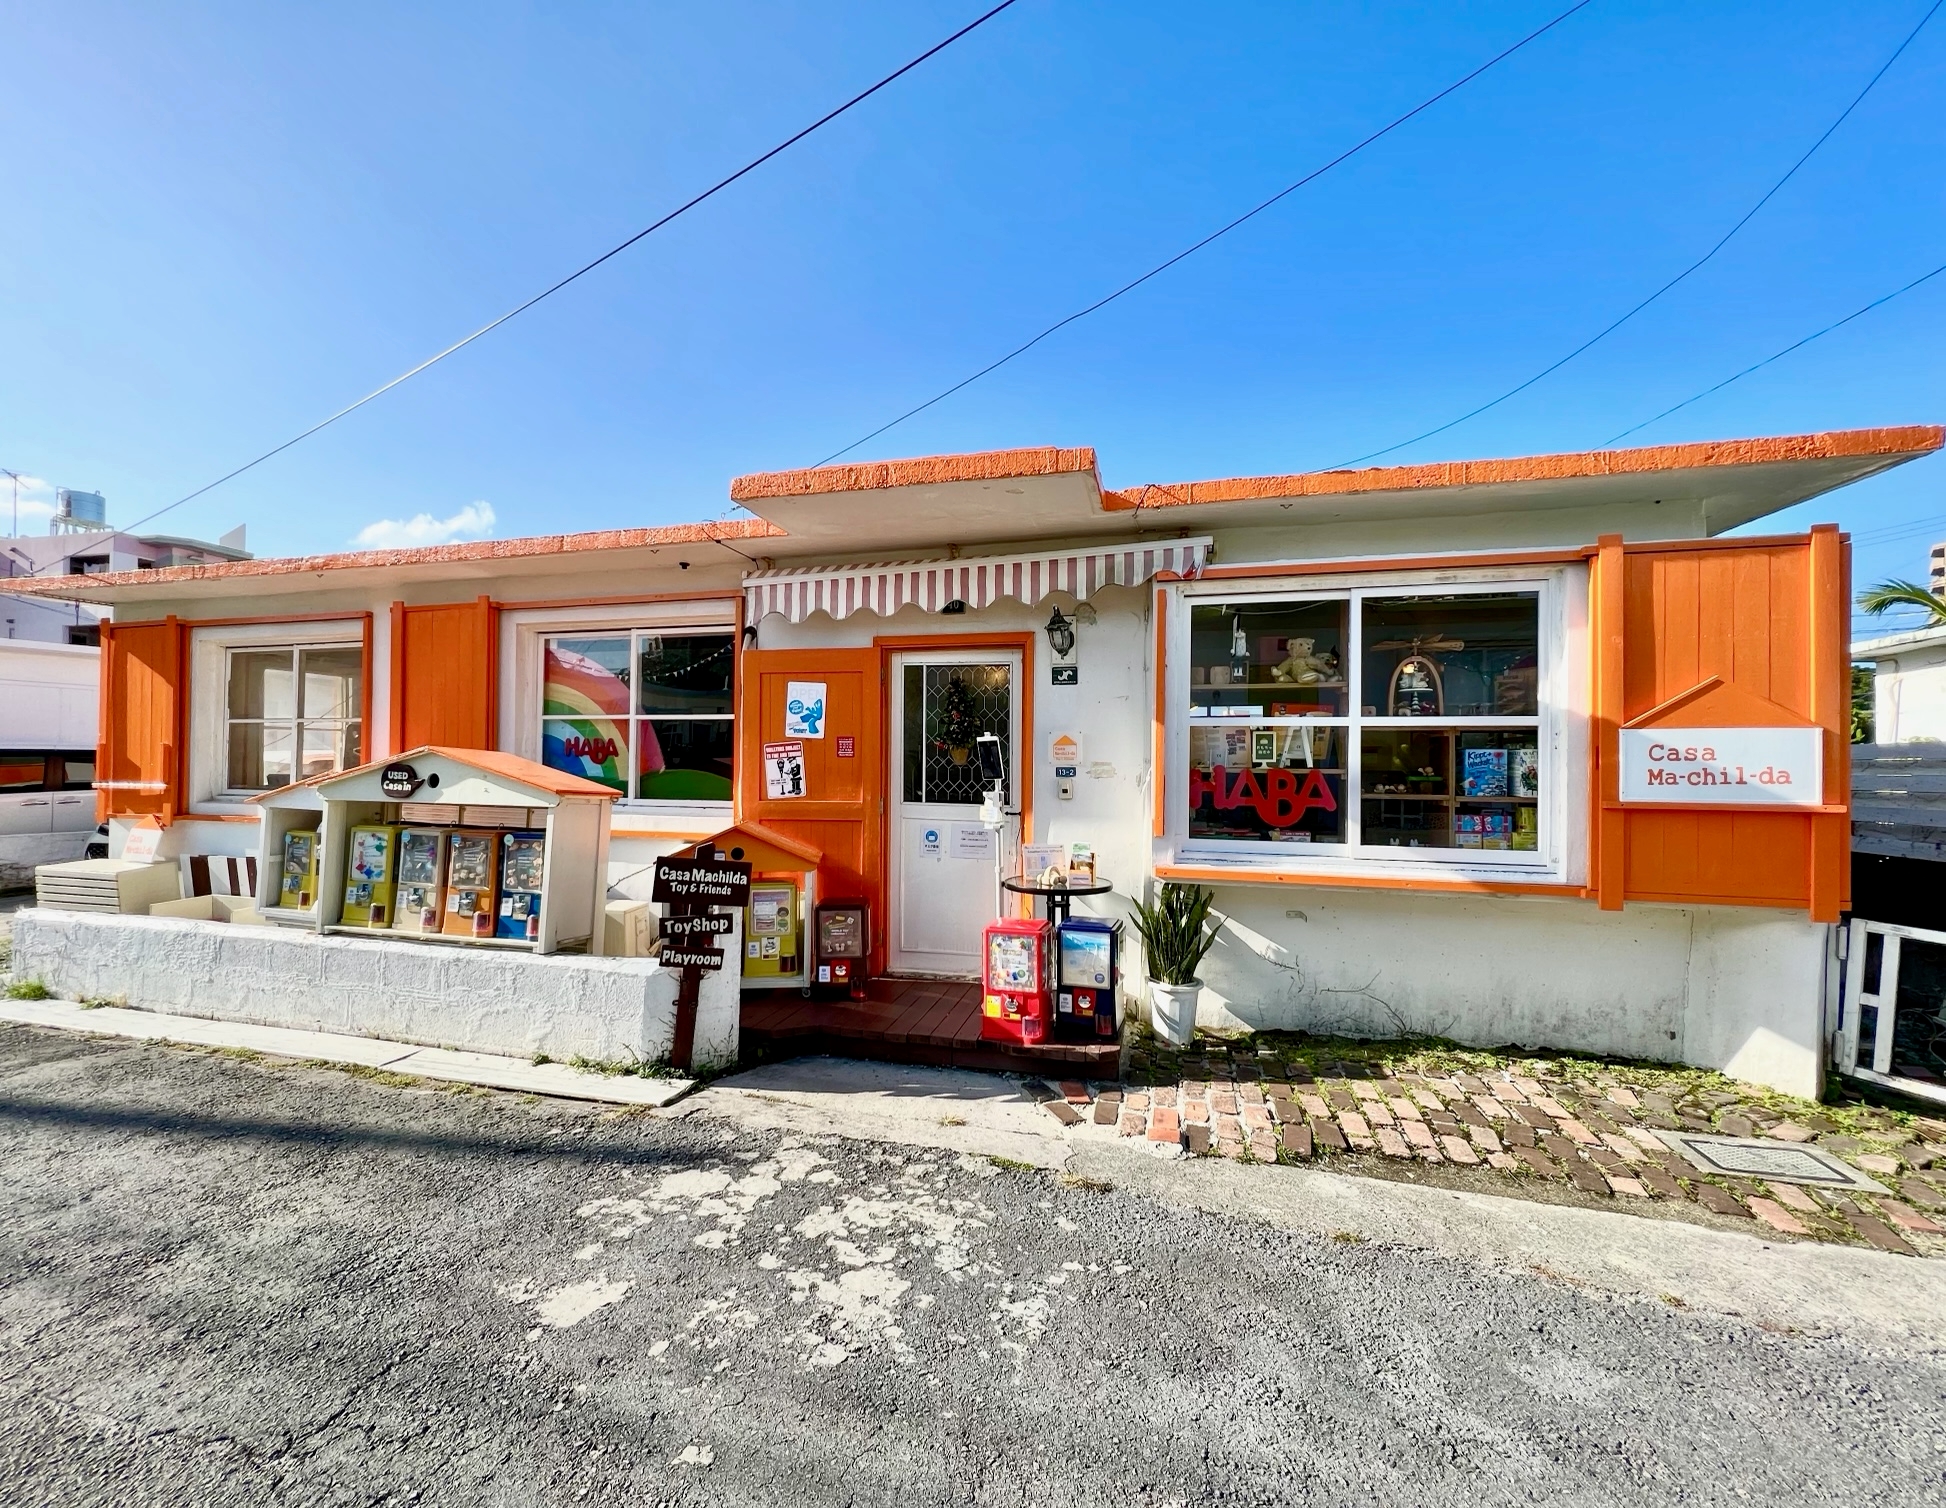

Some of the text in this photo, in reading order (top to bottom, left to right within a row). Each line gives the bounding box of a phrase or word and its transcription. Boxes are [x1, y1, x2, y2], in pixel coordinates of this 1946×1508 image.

[564, 736, 619, 765] HABA
[1648, 744, 1717, 762] Casa
[387, 771, 409, 780] USED
[1058, 768, 1074, 776] 13-2
[1647, 767, 1793, 786] Ma-chil-da
[1190, 764, 1337, 828] HABA
[659, 866, 748, 885] Casa Machilda
[669, 882, 732, 896] Toy & Friends
[662, 950, 721, 966] Playroom
